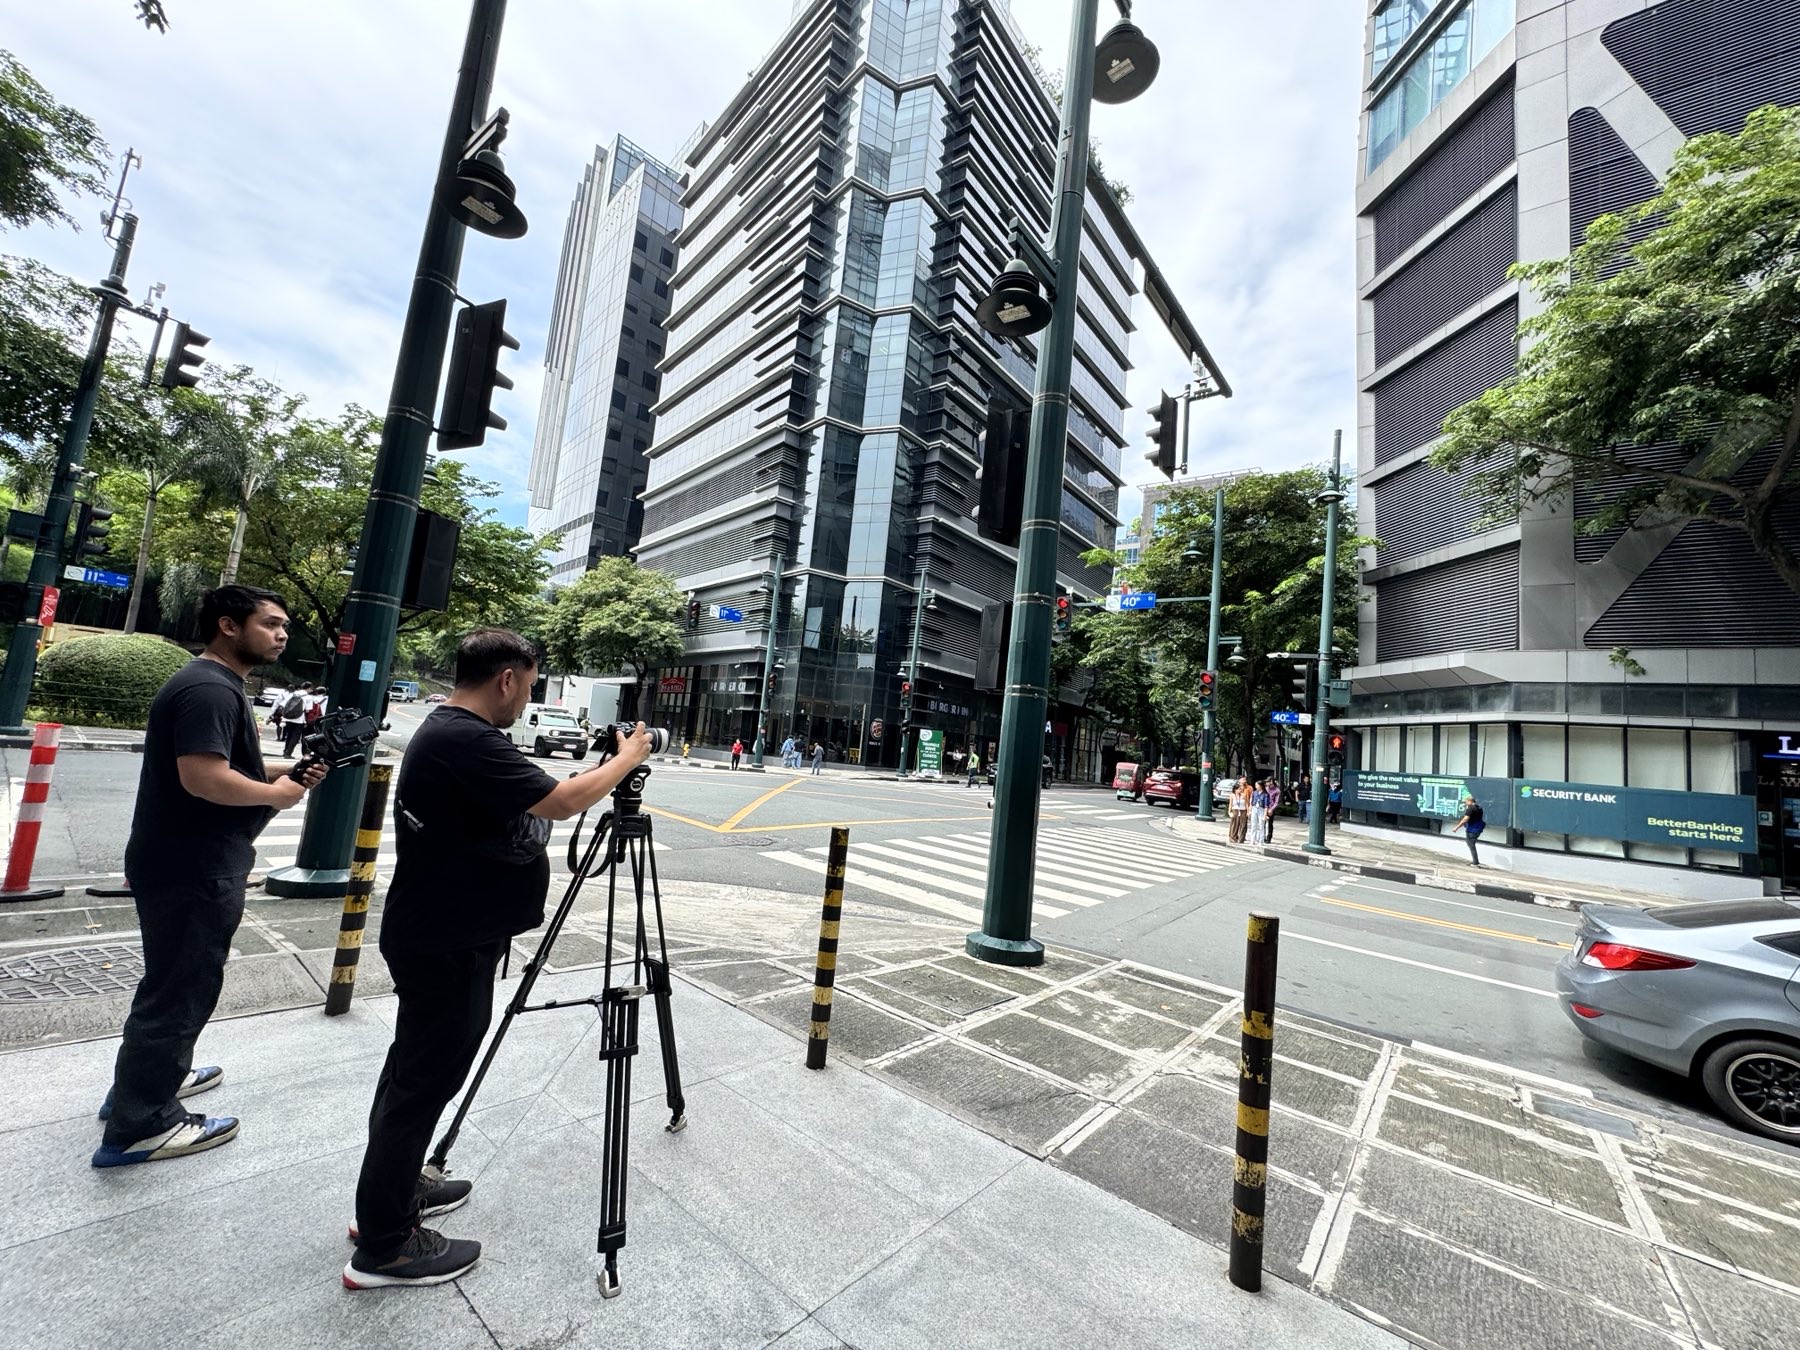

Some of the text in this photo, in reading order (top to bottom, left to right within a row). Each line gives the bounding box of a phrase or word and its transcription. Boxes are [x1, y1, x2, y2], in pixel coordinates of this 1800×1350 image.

[1122, 596, 1141, 607] 40th
[1273, 713, 1290, 722] 40th
[1367, 774, 1378, 782] give
[1376, 782, 1399, 790] business
[1532, 788, 1616, 804] SECURITY BANK
[1647, 817, 1743, 835] BetterBanking
[1668, 829, 1744, 842] starts here.
